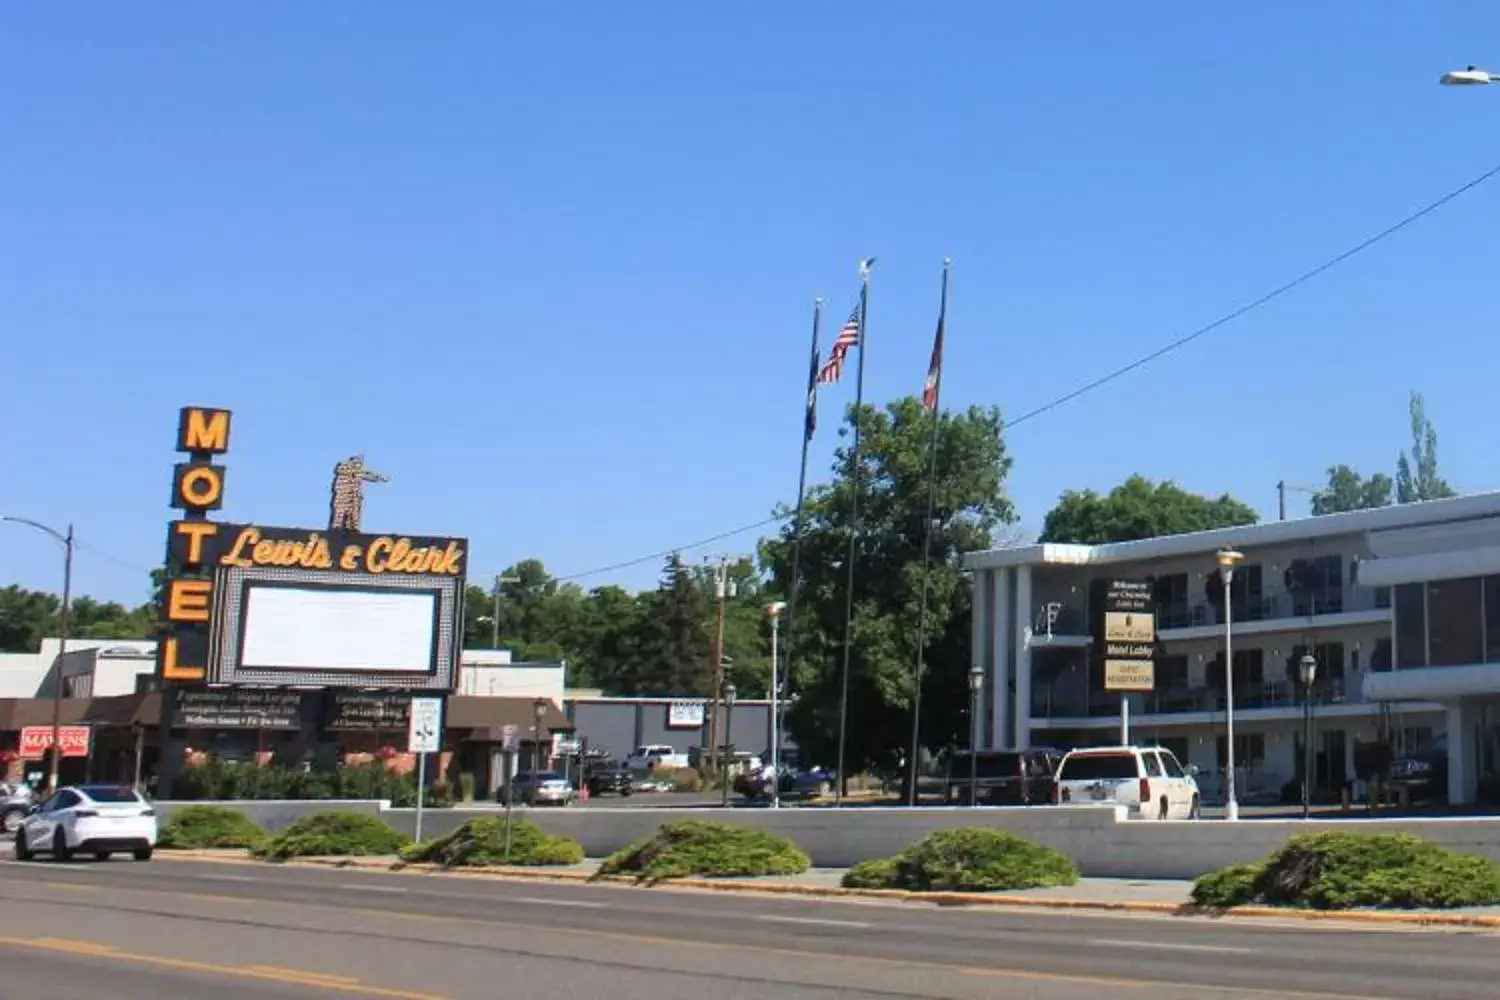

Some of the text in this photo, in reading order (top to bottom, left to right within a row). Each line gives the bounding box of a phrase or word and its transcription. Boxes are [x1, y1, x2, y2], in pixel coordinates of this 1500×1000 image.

[163, 409, 229, 680] MOTEL
[219, 527, 333, 569] Lewis
[366, 535, 465, 575] Clark
